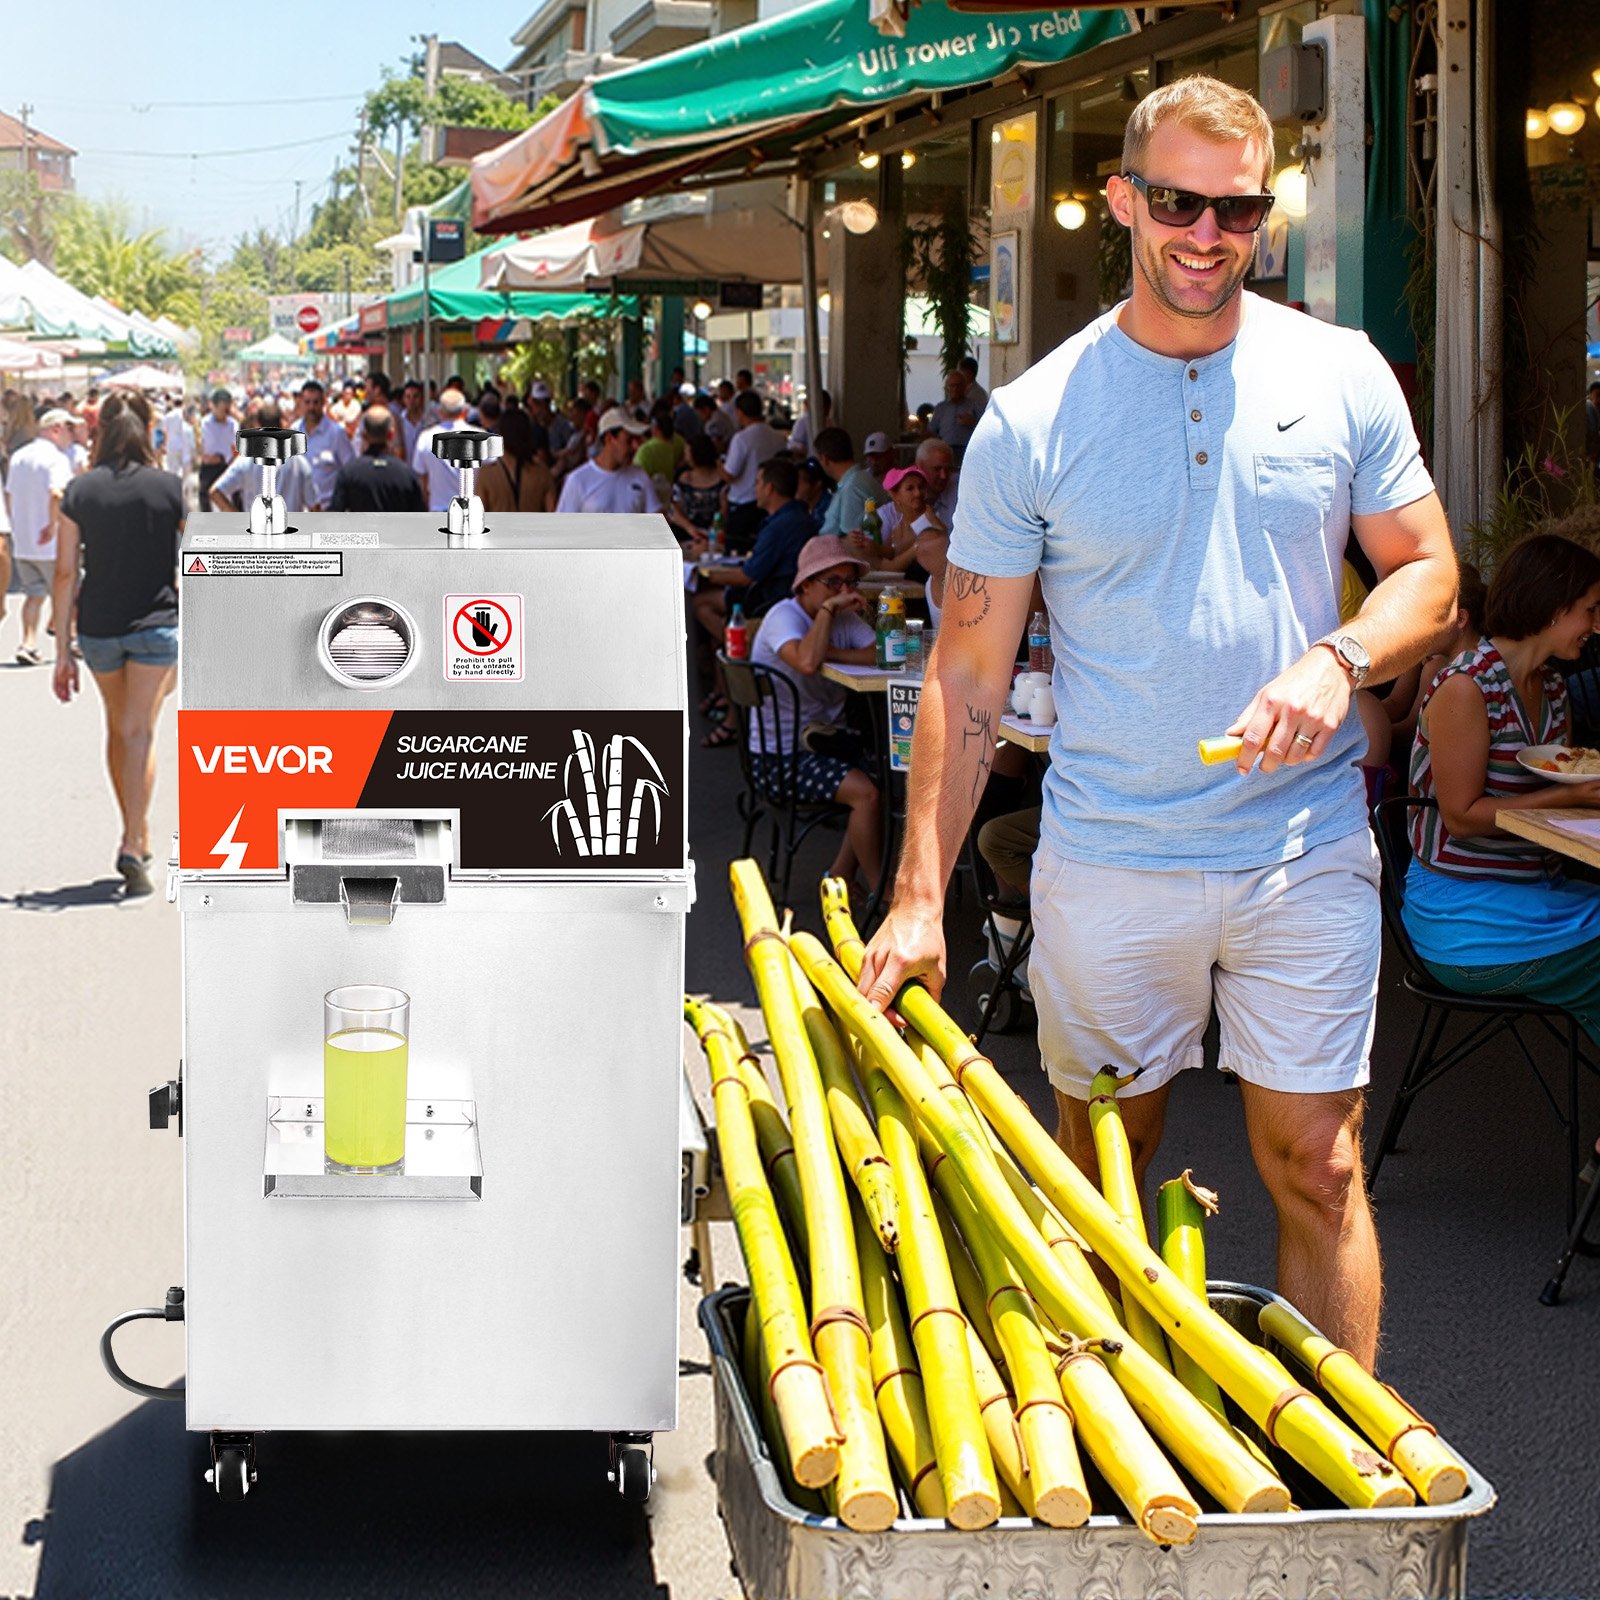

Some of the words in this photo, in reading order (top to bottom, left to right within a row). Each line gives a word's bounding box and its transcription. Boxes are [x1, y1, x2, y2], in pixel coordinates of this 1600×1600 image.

[396, 735, 528, 754] SUGARCANE
[191, 745, 333, 774] VEVOR
[396, 761, 457, 780] JUICE
[459, 762, 558, 780] MACHINE
